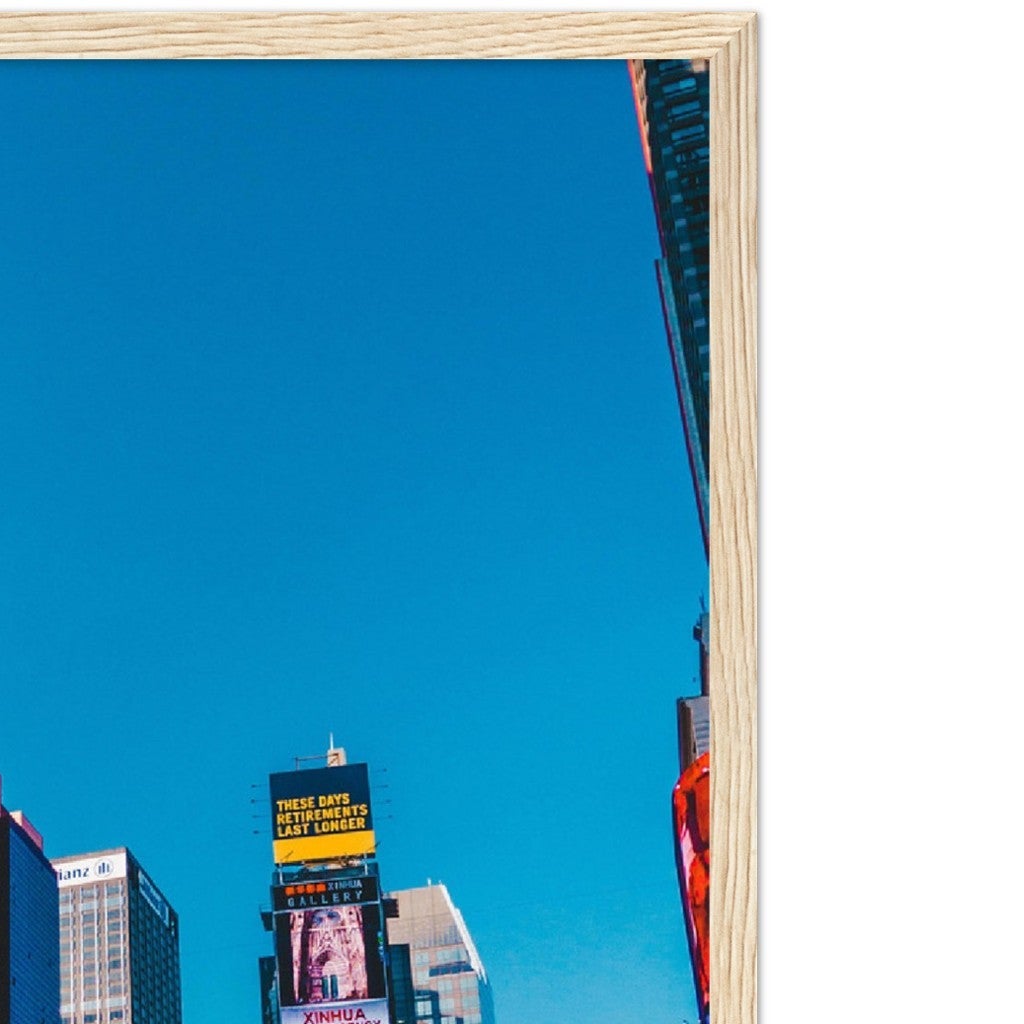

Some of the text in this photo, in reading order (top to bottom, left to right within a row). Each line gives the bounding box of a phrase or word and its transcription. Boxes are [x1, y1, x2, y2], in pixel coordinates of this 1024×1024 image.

[276, 793, 350, 812] THESE DAYS
[276, 804, 368, 825] RETIREMENTS
[277, 817, 365, 838] LAST LONGER
[287, 890, 362, 907] GALLERY
[303, 1007, 366, 1024] XINHUA
